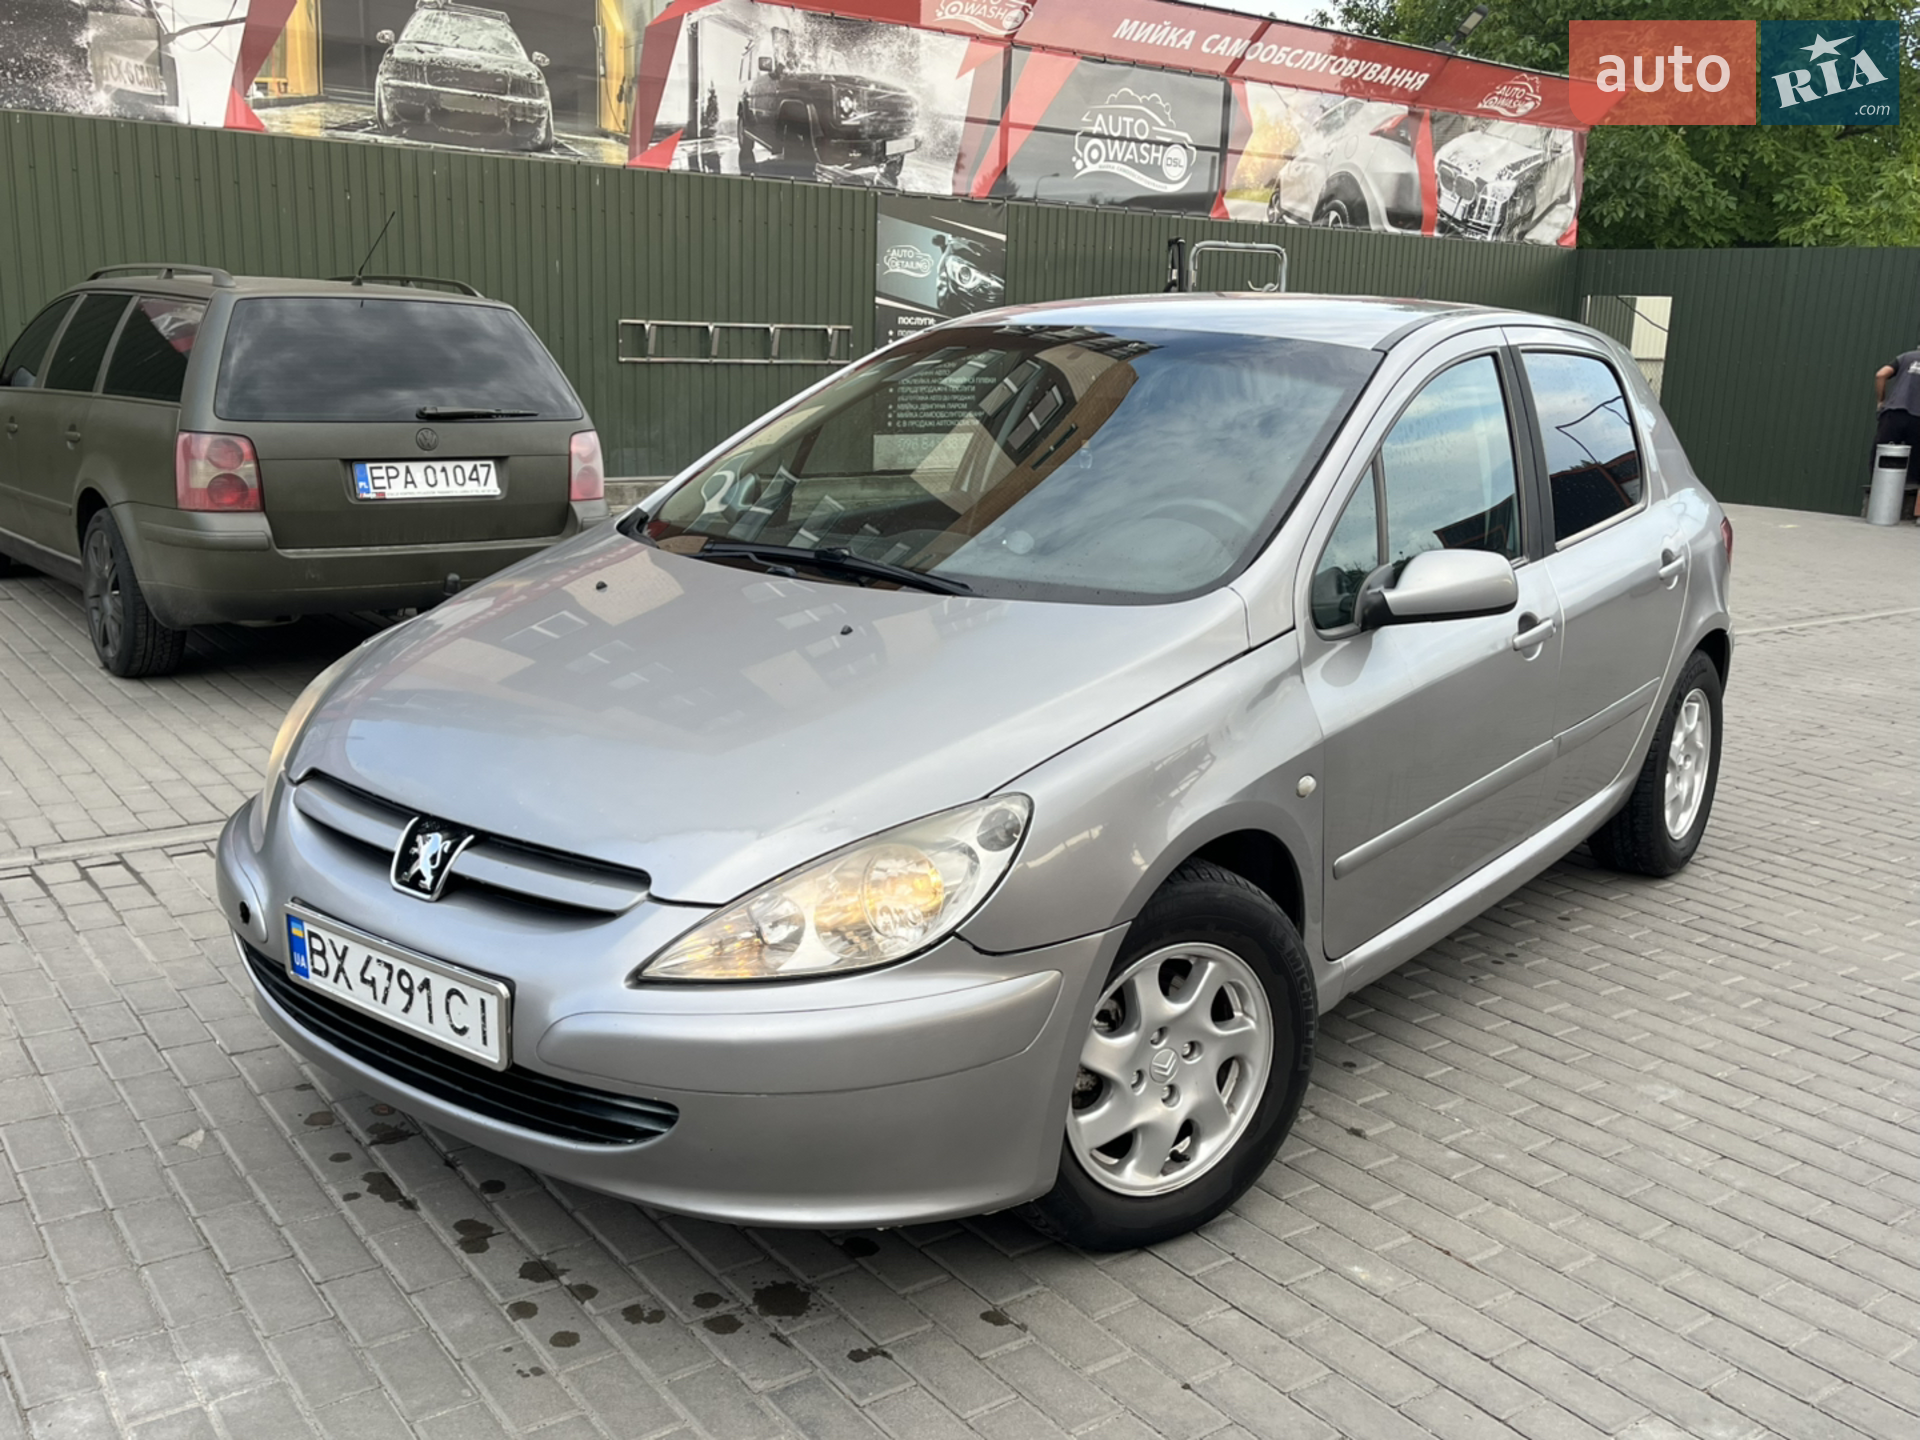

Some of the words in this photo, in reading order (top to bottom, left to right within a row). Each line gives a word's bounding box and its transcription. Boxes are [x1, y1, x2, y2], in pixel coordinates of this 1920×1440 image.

[964, 3, 1007, 20] WASH
[1112, 18, 1196, 50] МИЙКА
[1201, 33, 1430, 91] САМООБСЛУГОВУВАННЯ
[1497, 85, 1526, 99] AUTO
[1093, 113, 1149, 139] AUTO
[1107, 139, 1163, 165] WASH
[1166, 156, 1184, 169] DSL
[890, 248, 914, 258] AUTO
[890, 259, 929, 271] DETAILING
[369, 464, 418, 491] EPA
[423, 463, 492, 488] 01047
[293, 952, 307, 969] UA
[307, 929, 353, 991] BX
[359, 954, 435, 1025] 4791
[443, 987, 489, 1047] CI
